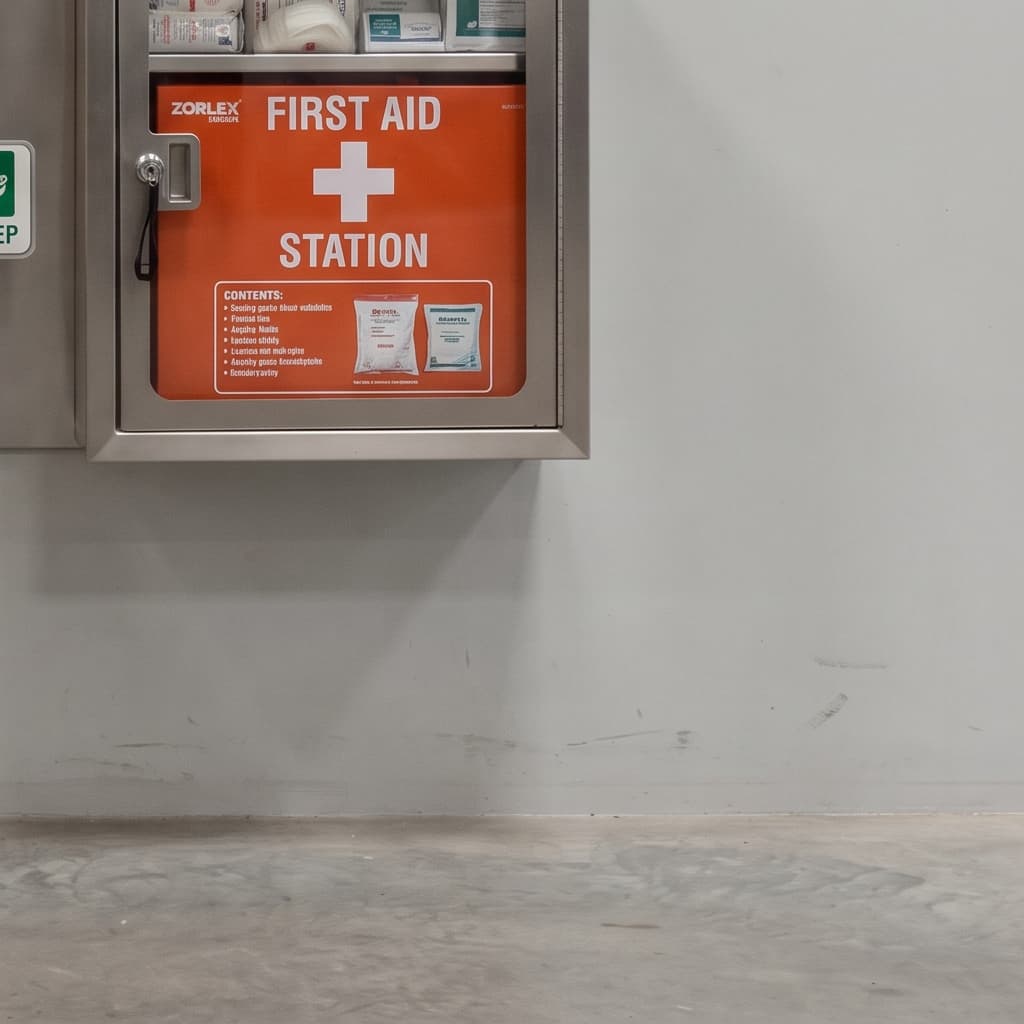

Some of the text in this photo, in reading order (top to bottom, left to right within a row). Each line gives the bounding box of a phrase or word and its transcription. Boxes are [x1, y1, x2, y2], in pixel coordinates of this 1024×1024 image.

[171, 102, 239, 115] ZORLEX
[267, 95, 441, 131] FIRST AID
[279, 232, 428, 268] STATION
[224, 290, 283, 300] CONTENTS:
